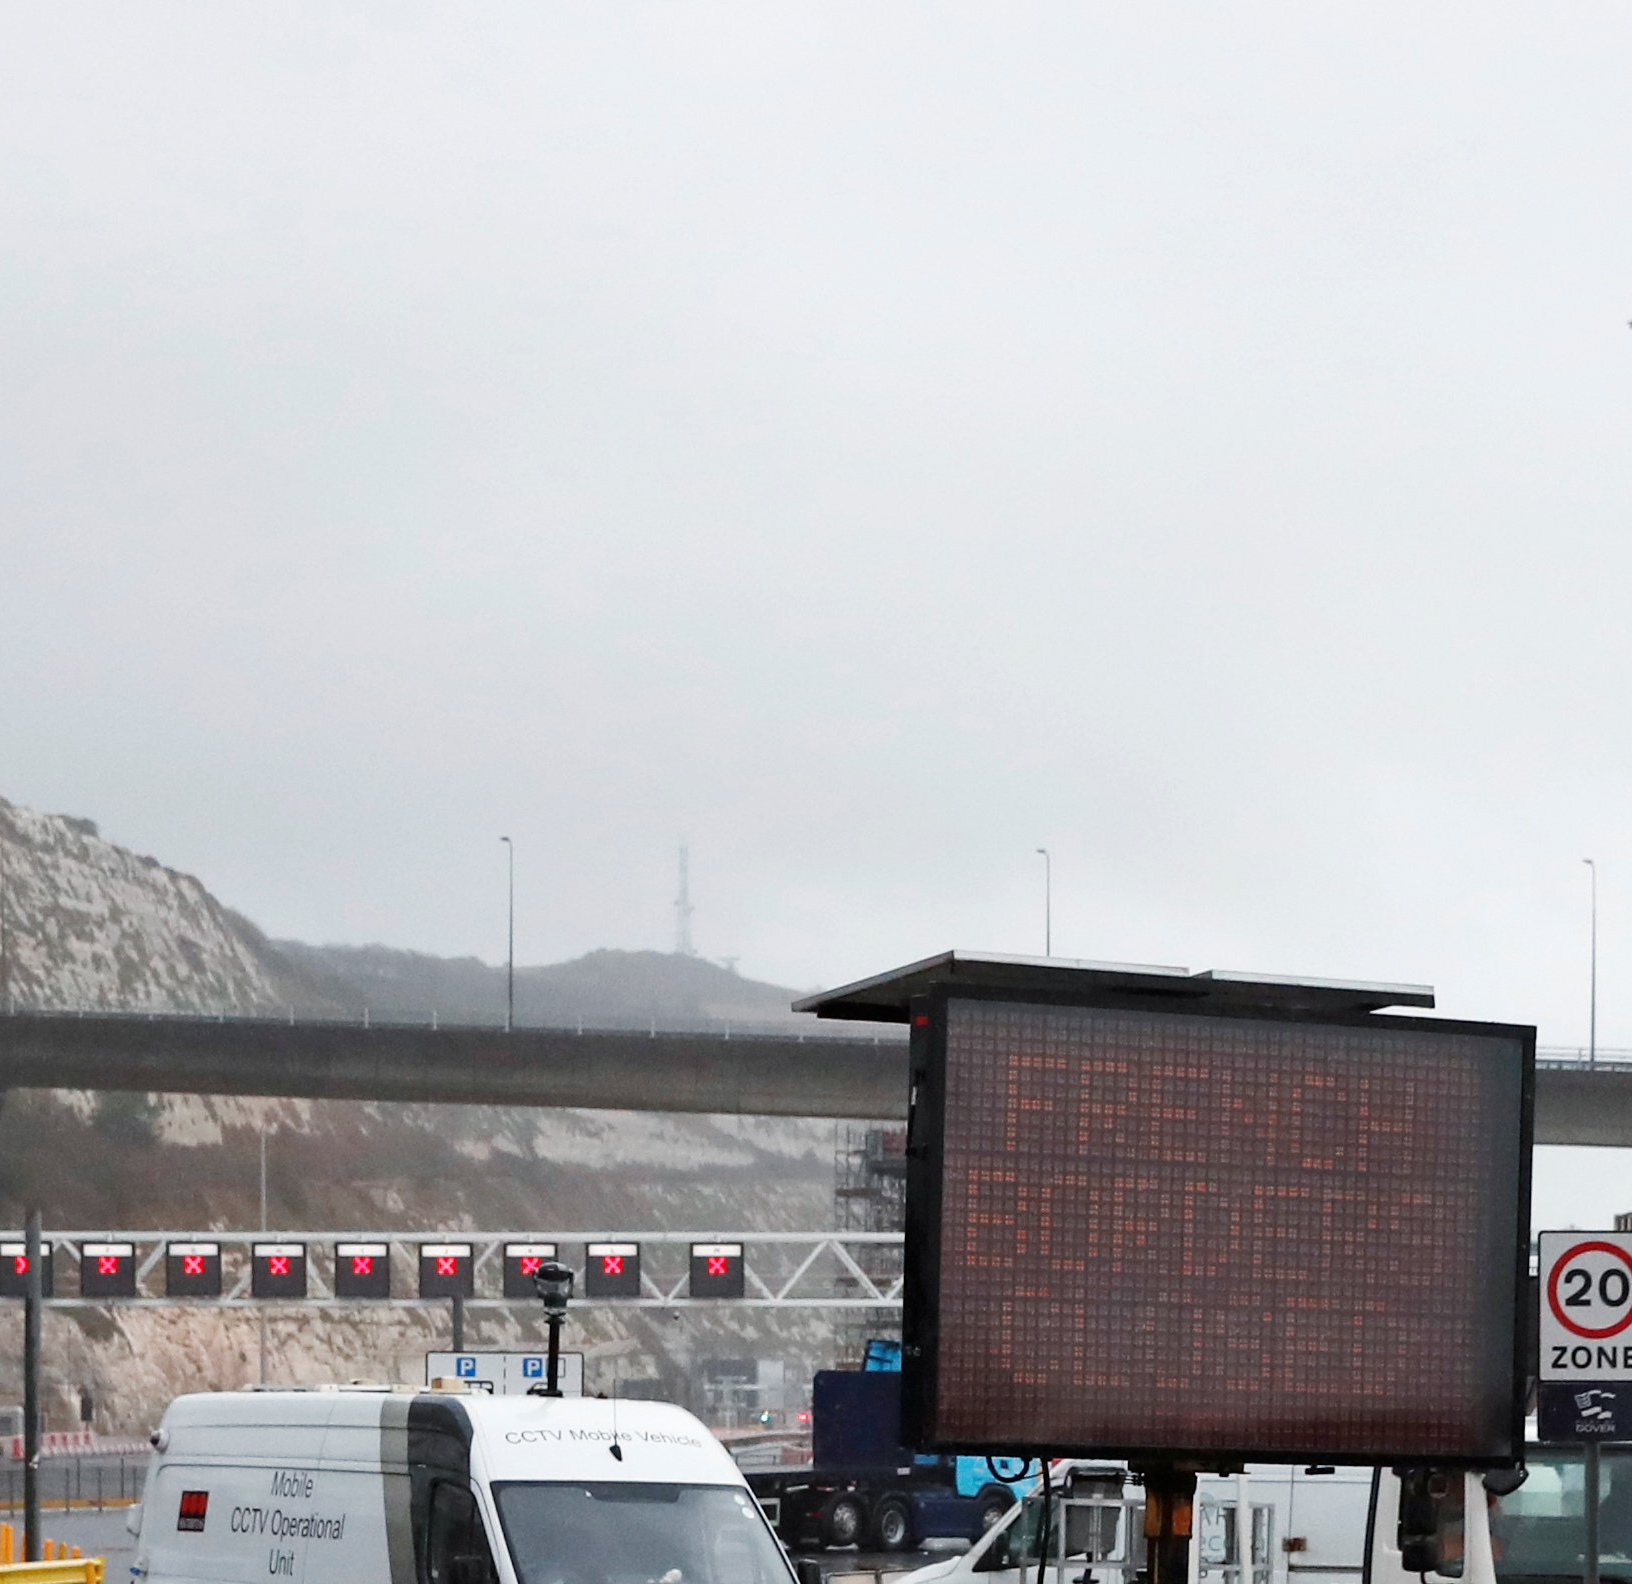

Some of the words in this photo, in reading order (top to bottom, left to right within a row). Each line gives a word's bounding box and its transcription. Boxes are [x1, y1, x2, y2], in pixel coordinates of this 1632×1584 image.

[1007, 1055, 1416, 1174] FRENCH
[966, 1168, 1444, 1288] BORDERS
[1563, 1268, 1630, 1307] 20
[1000, 1284, 1409, 1396] CLOSED
[459, 1359, 475, 1376] P
[526, 1359, 541, 1376] P
[505, 1429, 563, 1445] CCTV
[569, 1428, 633, 1442] Mobile
[635, 1430, 703, 1448] Vehicle
[270, 1471, 314, 1498] Mobile
[230, 1506, 269, 1535] CCTV
[270, 1509, 346, 1542] Operational
[268, 1549, 295, 1576] Unit
